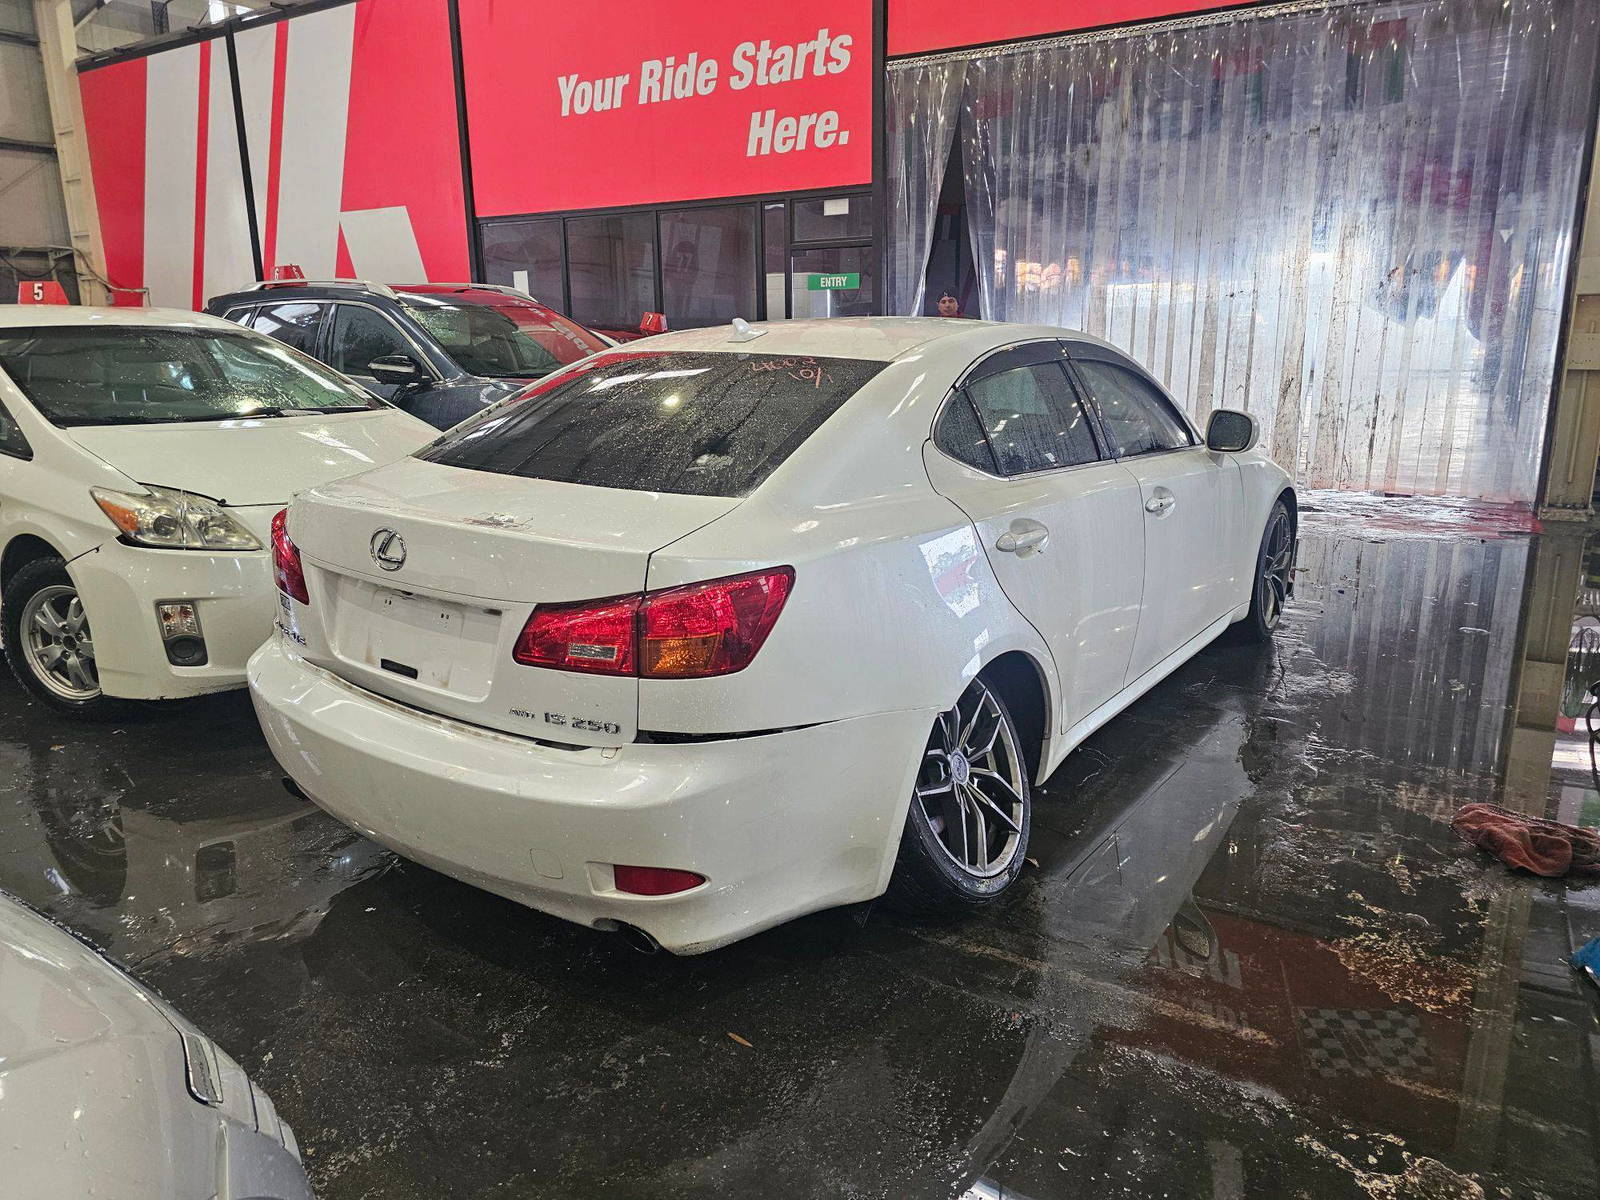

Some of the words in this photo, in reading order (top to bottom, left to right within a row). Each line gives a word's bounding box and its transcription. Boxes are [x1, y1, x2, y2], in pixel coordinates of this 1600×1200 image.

[557, 73, 630, 117] Your
[637, 51, 719, 105] Ride
[729, 28, 853, 90] Starts
[745, 109, 850, 157] Here.
[33, 282, 44, 301] 5
[820, 276, 848, 288] ENTRY
[646, 313, 653, 326] 7
[543, 712, 567, 726] IS
[571, 716, 622, 735] 250
